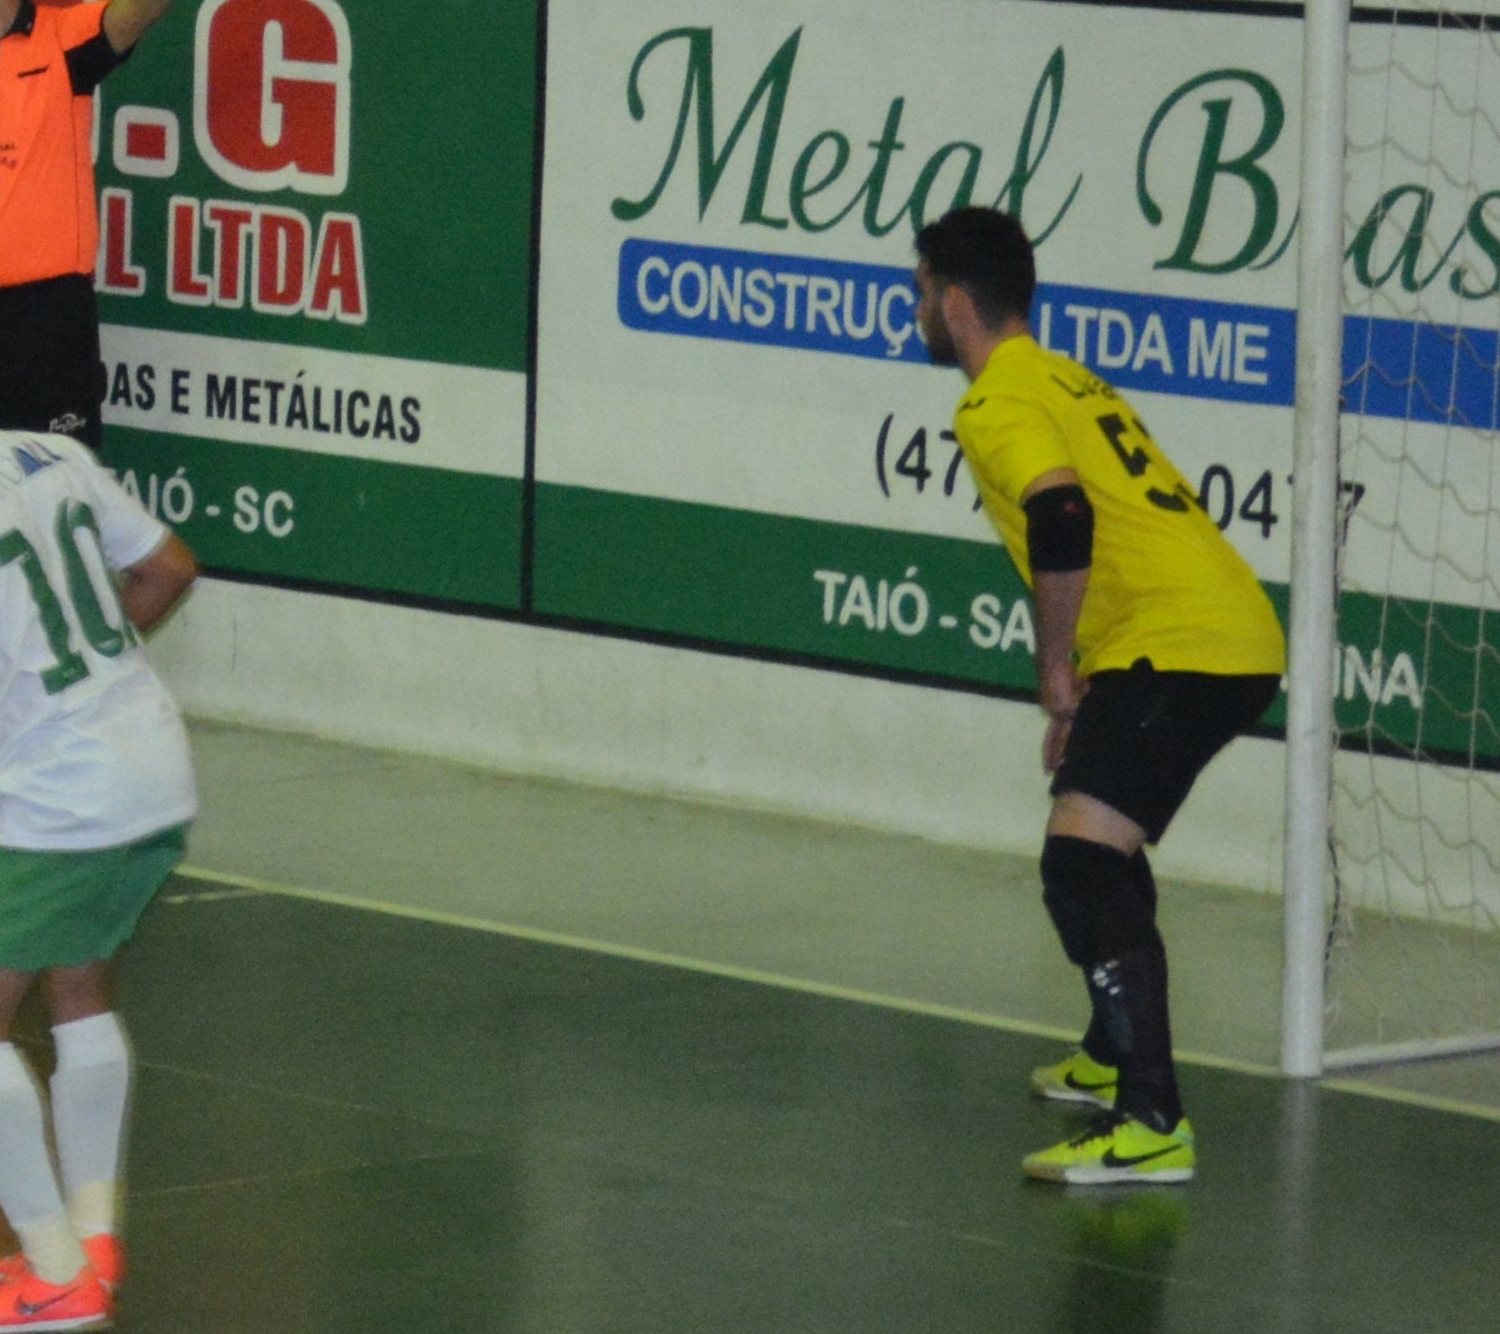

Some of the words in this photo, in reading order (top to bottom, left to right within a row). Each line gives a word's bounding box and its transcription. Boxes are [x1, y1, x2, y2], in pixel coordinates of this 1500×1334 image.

[609, 24, 1083, 247] Metal
[166, 193, 369, 327] LTDA
[1039, 302, 1174, 375] LTDA
[1187, 319, 1271, 386] ME
[170, 370, 192, 415] E
[204, 369, 423, 444] METÁLICAS
[234, 489, 294, 539] SC
[813, 567, 930, 637] TAIÓ
